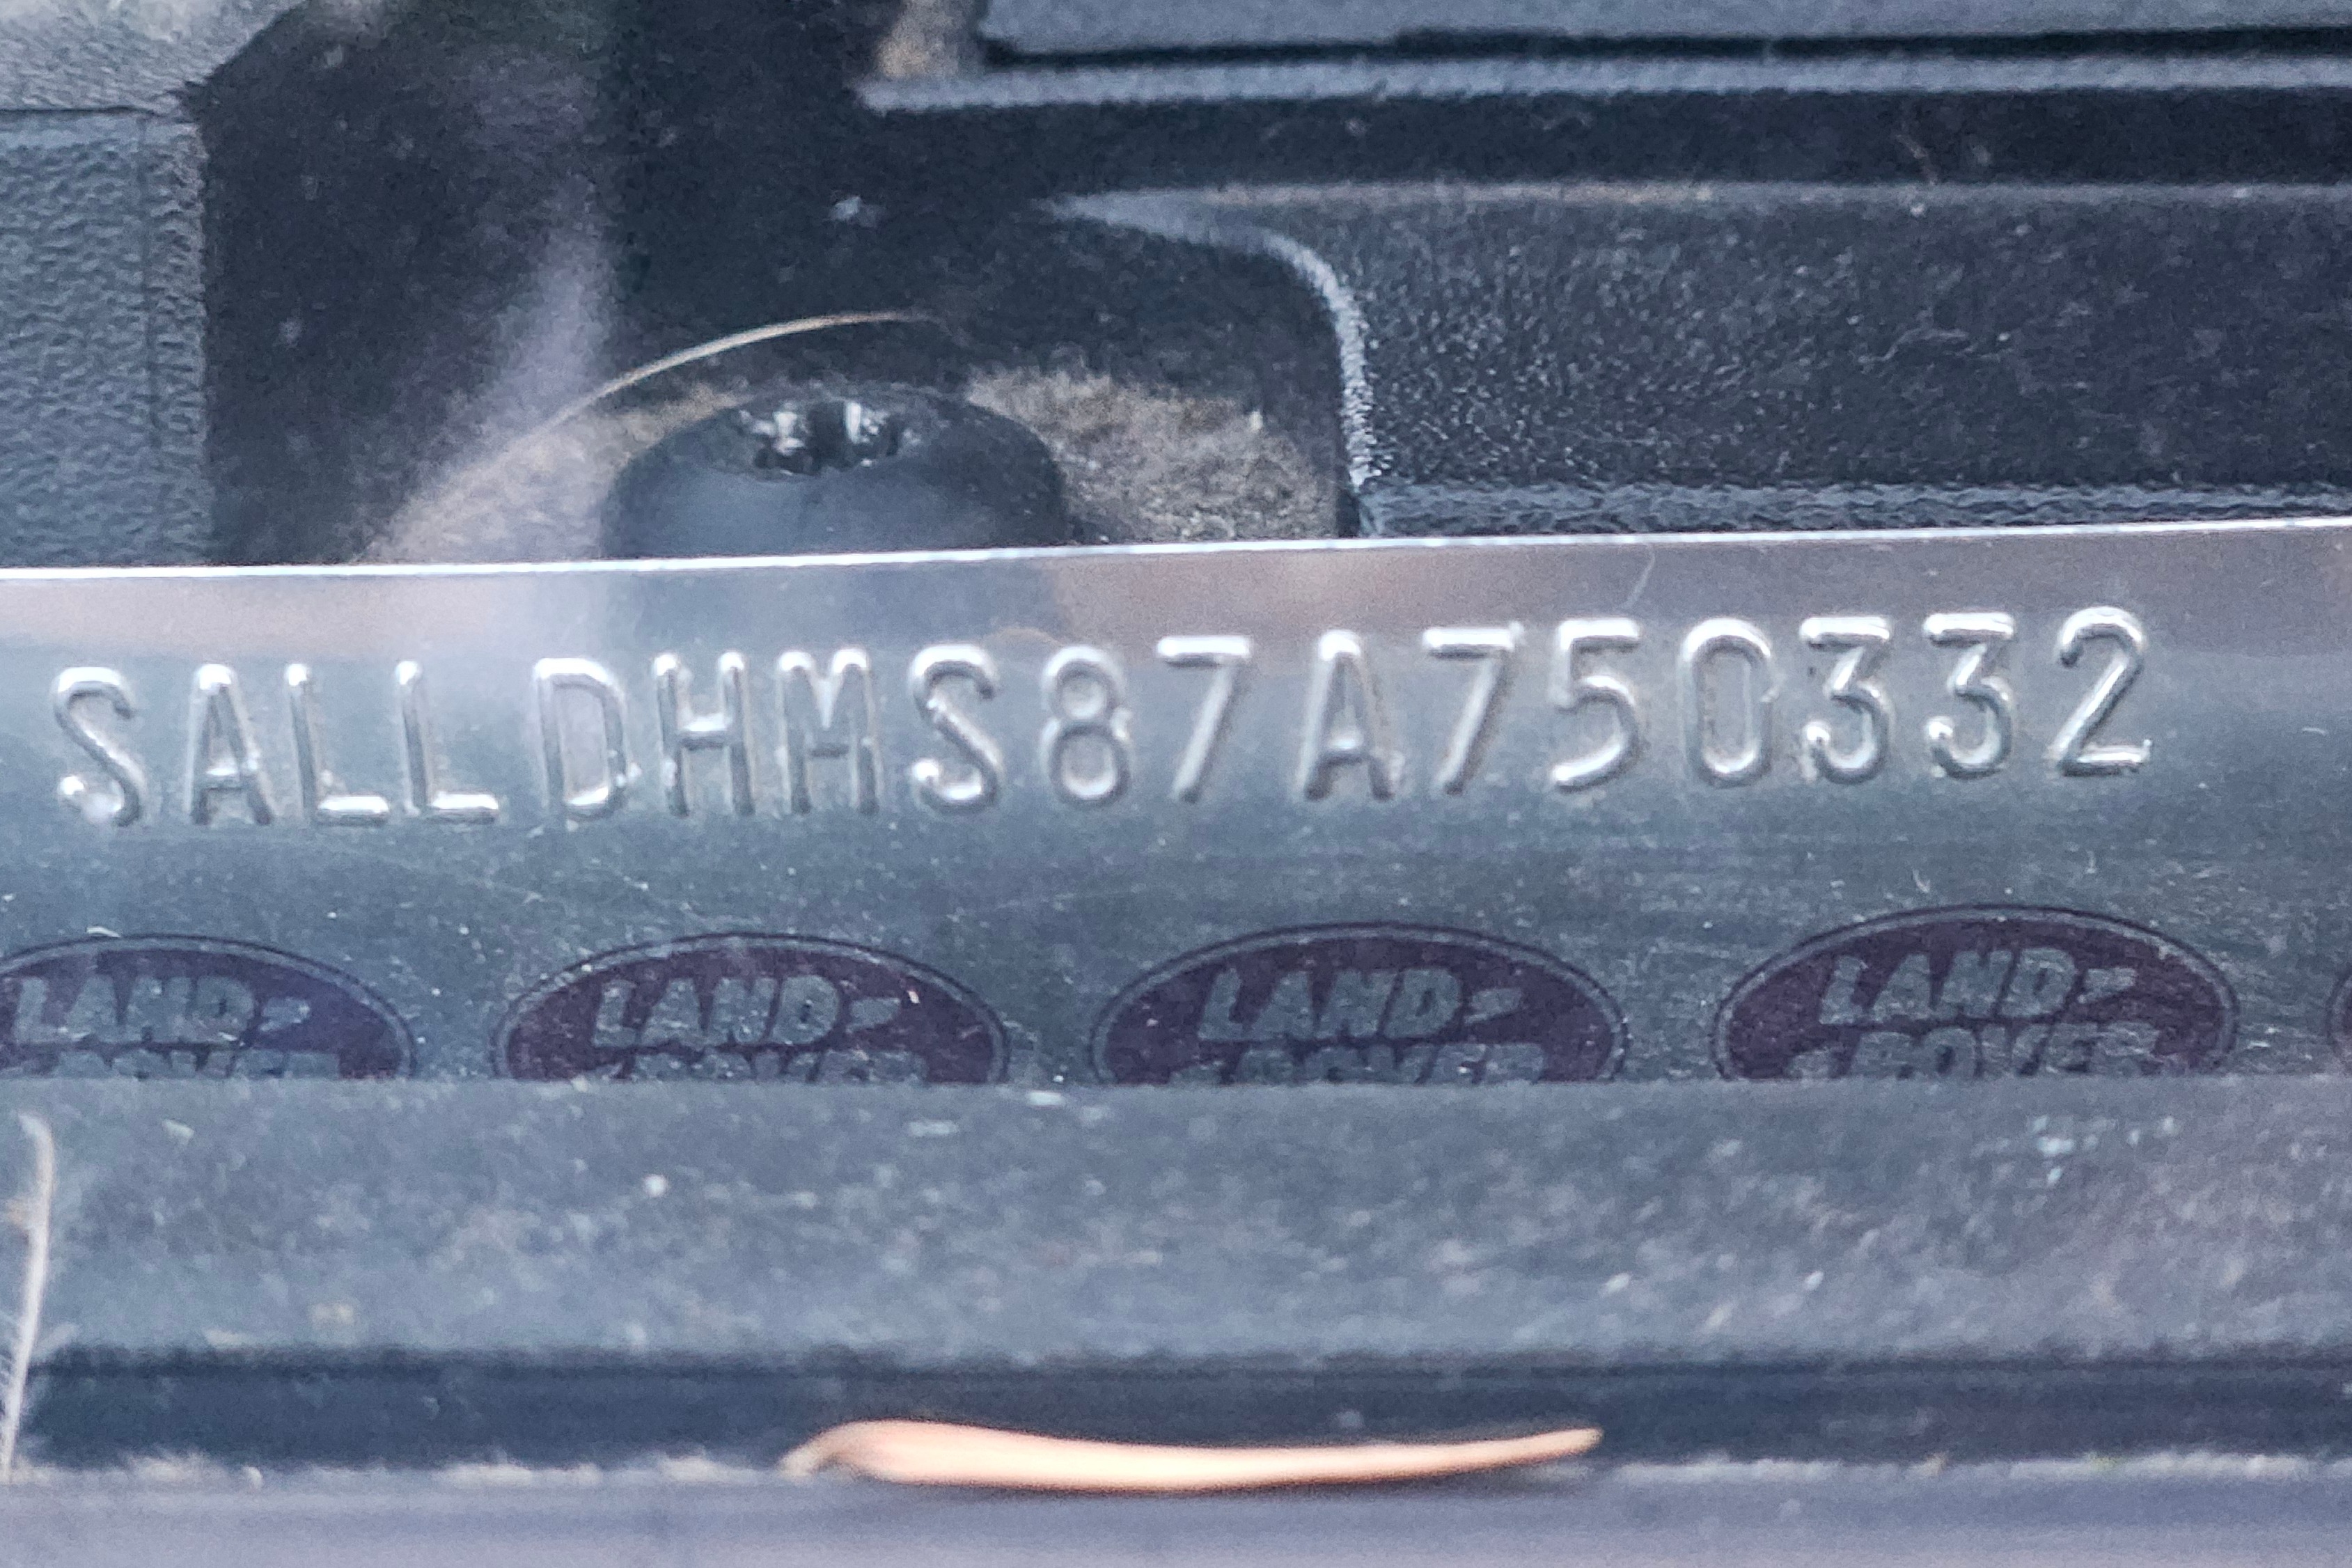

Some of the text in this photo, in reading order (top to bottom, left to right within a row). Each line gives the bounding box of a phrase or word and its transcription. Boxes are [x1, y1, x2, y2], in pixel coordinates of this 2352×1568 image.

[54, 605, 2154, 827] SALLDHMS87A750332
[592, 975, 838, 1047] LAND
[1196, 968, 1462, 1043] LAND
[1819, 947, 2078, 1026] LAND
